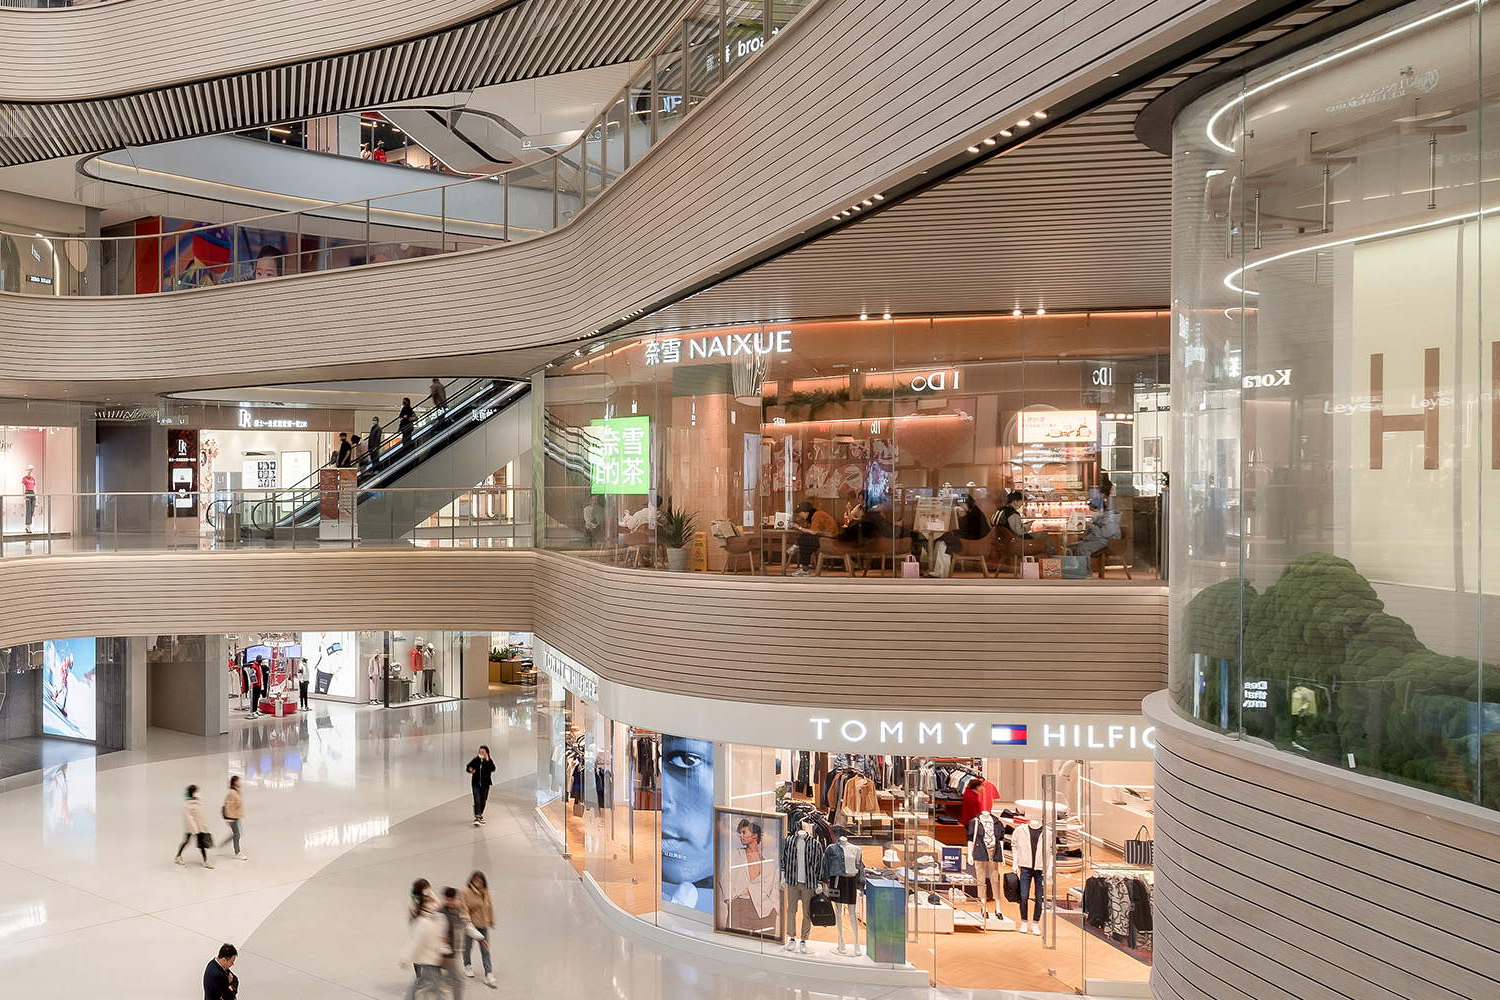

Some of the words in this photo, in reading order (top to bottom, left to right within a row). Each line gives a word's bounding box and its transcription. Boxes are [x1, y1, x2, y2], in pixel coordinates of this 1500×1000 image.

[644, 337, 682, 366] 奈雪
[689, 330, 793, 360] NAIXUE
[601, 425, 645, 456] 奈雪
[217, 476, 225, 484] L1
[596, 457, 645, 486] 的茶
[809, 718, 976, 745] TOMMY
